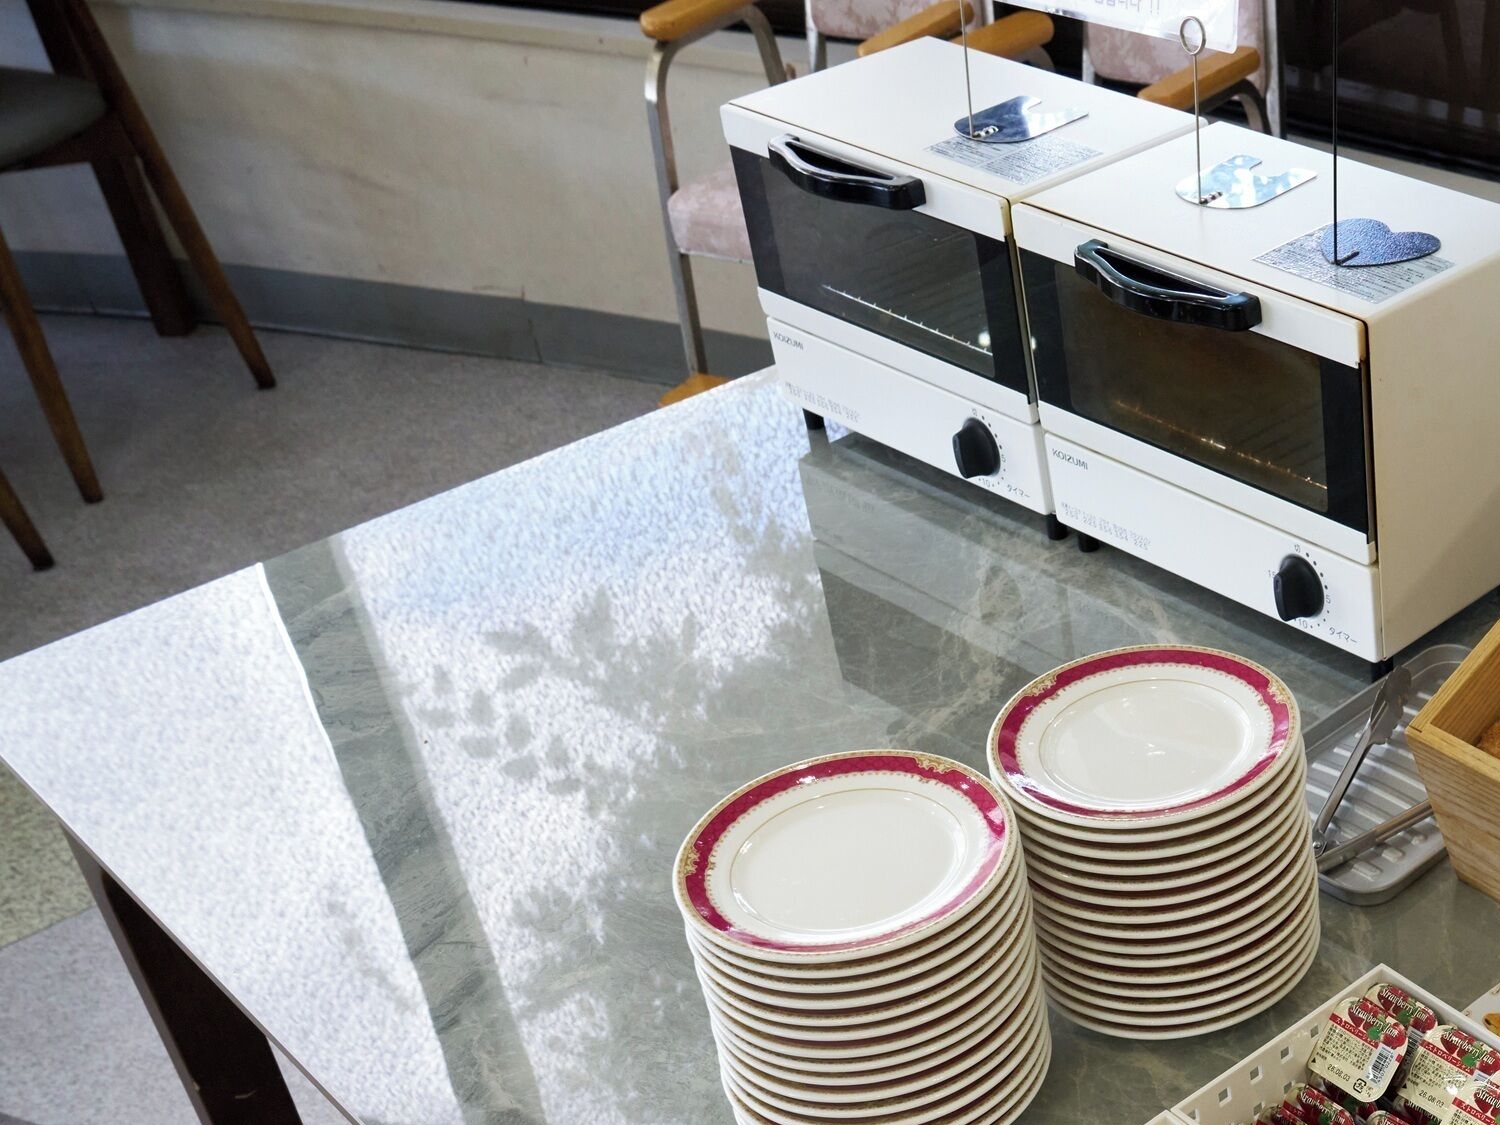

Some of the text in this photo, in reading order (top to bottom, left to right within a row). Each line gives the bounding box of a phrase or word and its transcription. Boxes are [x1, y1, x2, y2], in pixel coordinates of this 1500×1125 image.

[773, 331, 804, 351] KOIZUMI
[1052, 448, 1089, 471] KOIZUMI
[1329, 626, 1358, 644] タイマー
[1380, 987, 1428, 1022] Strawberry Jam
[1350, 1003, 1398, 1038] Strawberry Jam
[1443, 1031, 1496, 1065] Strawberry Jam
[1327, 1063, 1351, 1082] 26.08.03
[1419, 1089, 1444, 1108] 26.08.03
